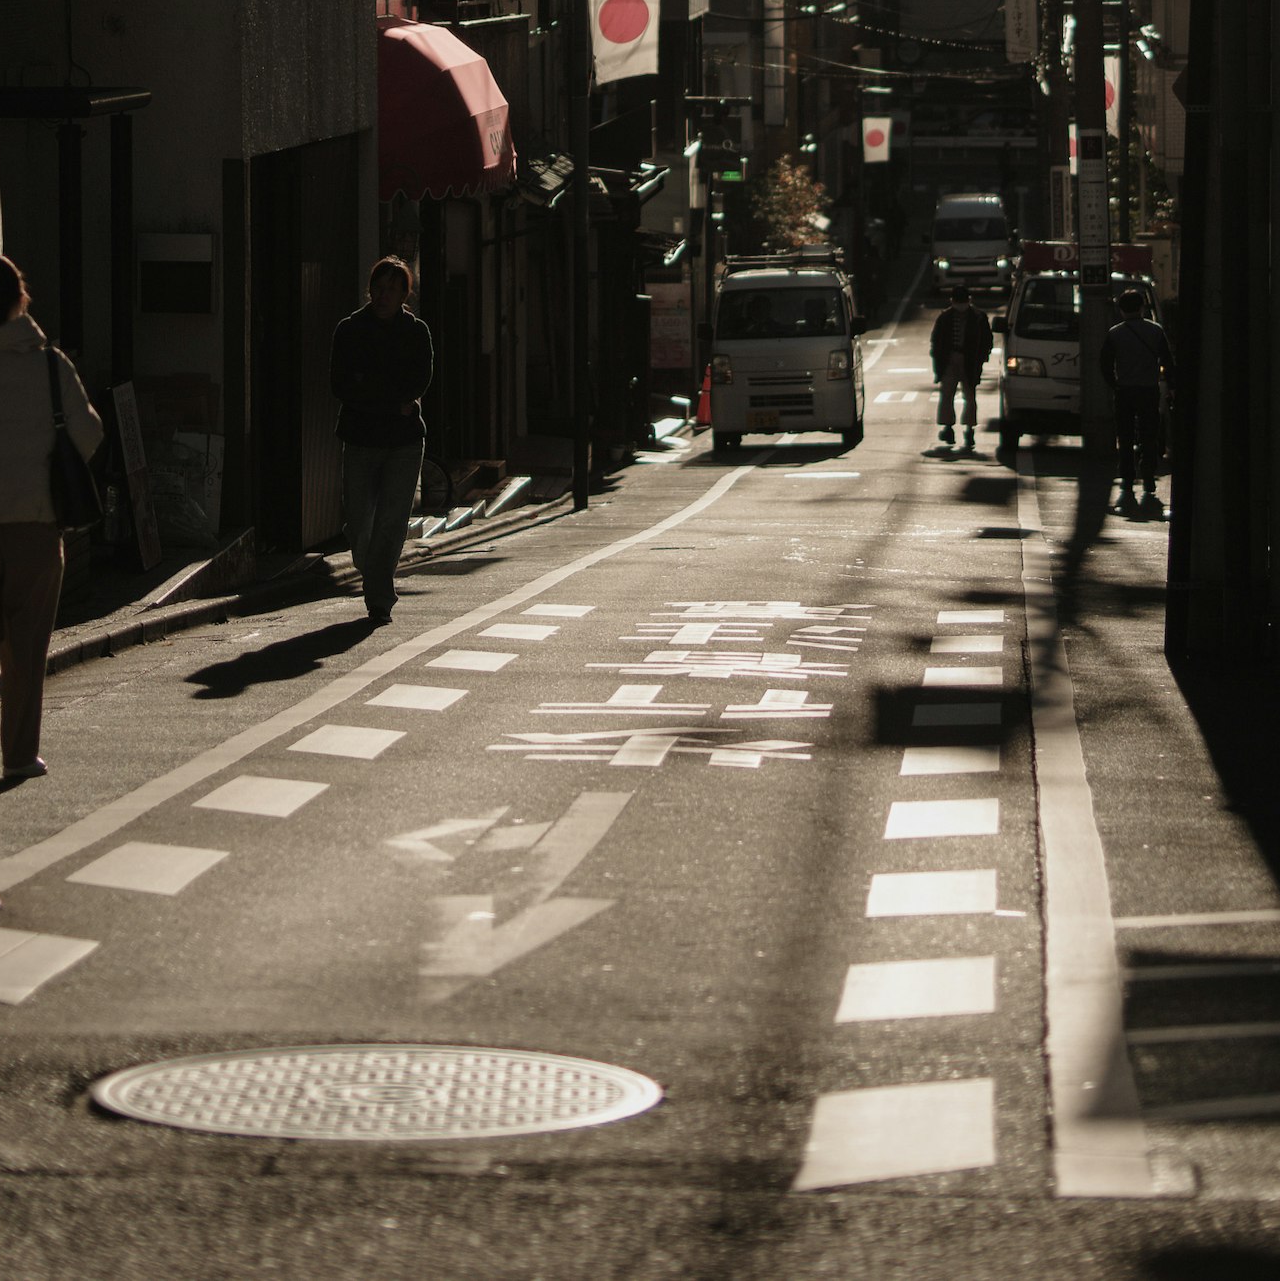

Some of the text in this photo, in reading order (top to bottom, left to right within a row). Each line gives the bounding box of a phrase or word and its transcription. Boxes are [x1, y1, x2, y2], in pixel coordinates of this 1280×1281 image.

[485, 600, 878, 769] 歩行者注意
